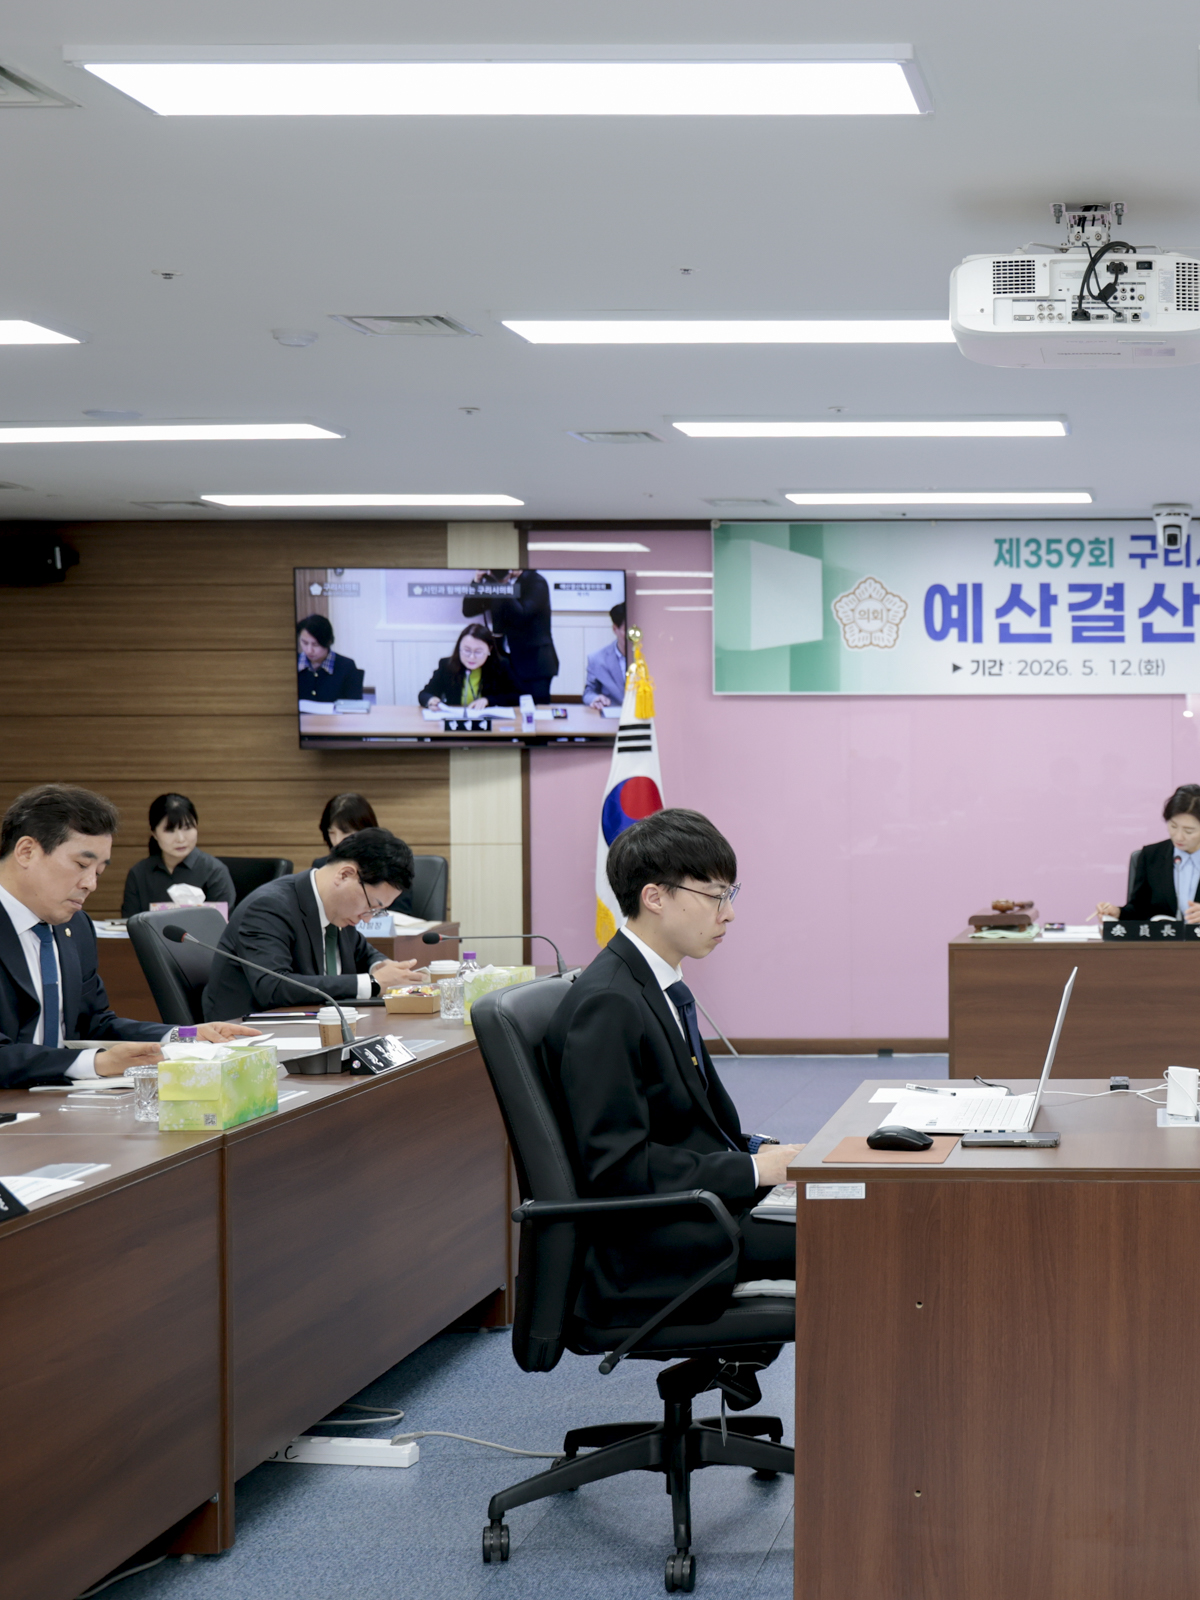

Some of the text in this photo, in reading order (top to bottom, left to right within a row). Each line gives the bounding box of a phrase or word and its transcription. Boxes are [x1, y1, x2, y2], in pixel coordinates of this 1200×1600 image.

[993, 536, 1115, 569] 제359회
[858, 608, 884, 623] 의회
[970, 659, 1004, 676] 기간
[1017, 659, 1072, 676] 2026.
[1081, 659, 1098, 676] 5.
[1110, 923, 1176, 937] 委員長
